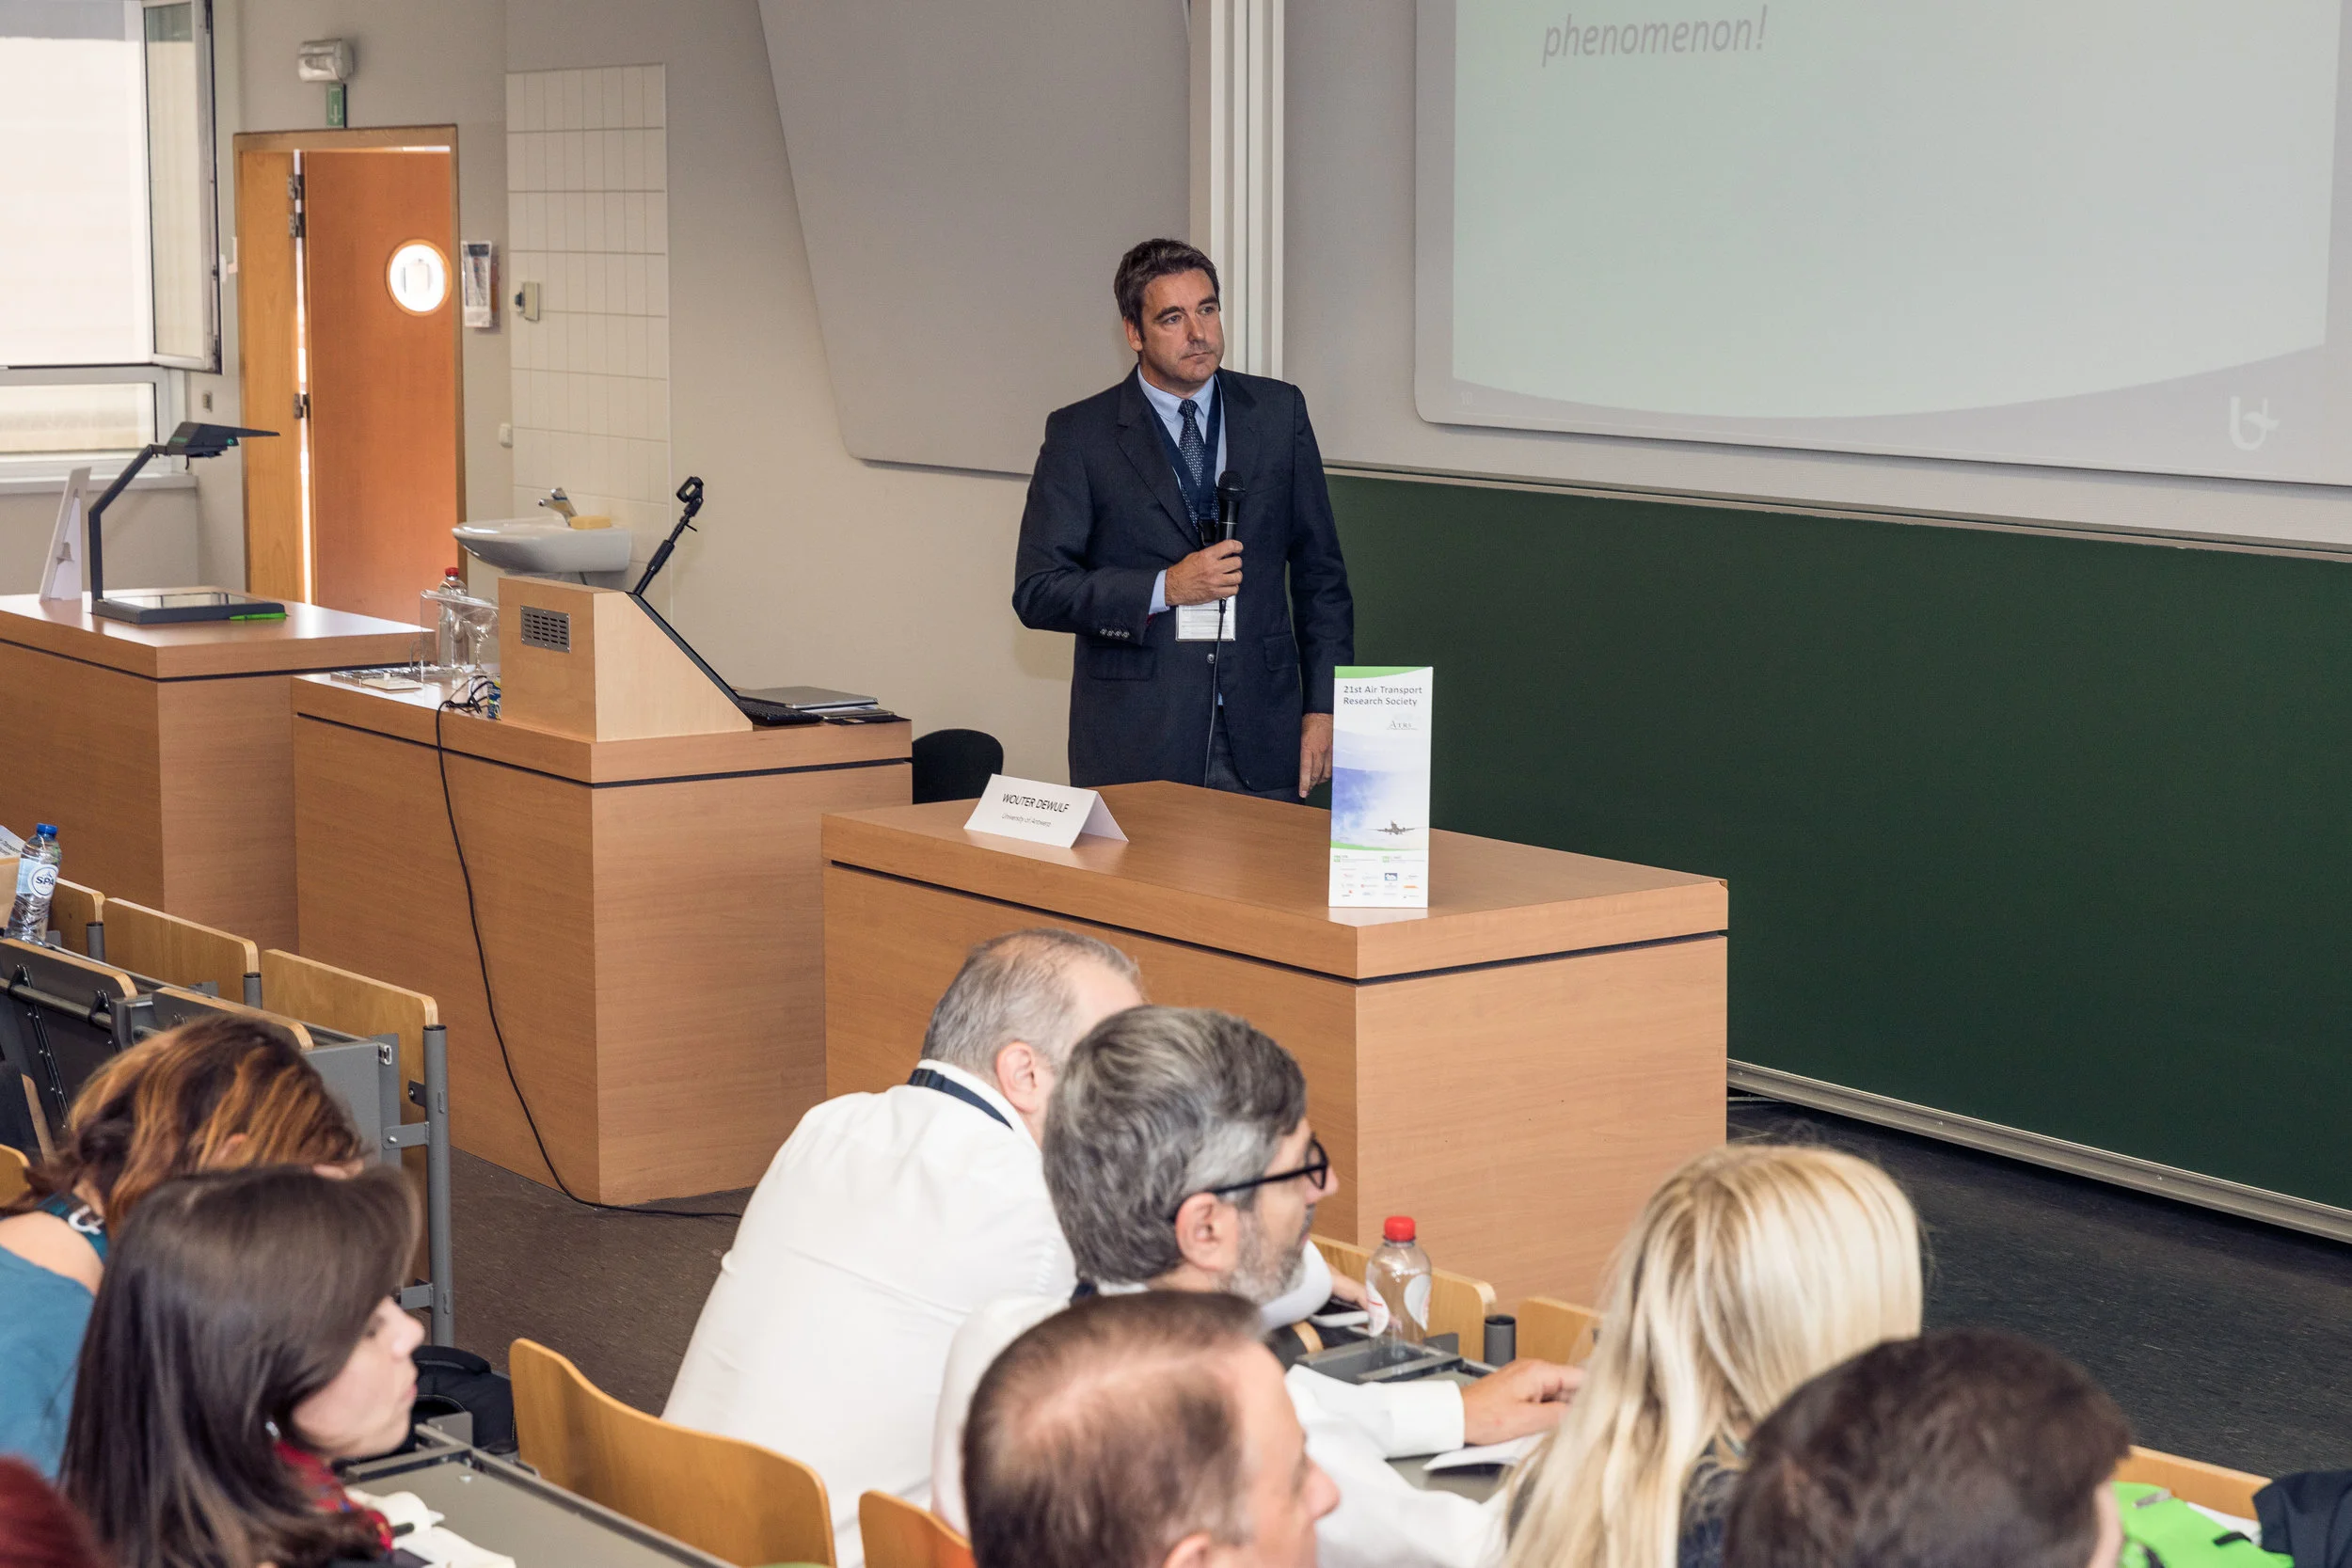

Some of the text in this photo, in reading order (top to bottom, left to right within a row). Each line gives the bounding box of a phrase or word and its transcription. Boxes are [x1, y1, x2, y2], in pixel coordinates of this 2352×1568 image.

[1541, 4, 1768, 68] phenomenon!
[1380, 686, 1422, 695] Transport
[1343, 697, 1418, 706] Research Society
[1002, 793, 1070, 813] WOUTER DEWULF
[36, 876, 55, 886] SPA
